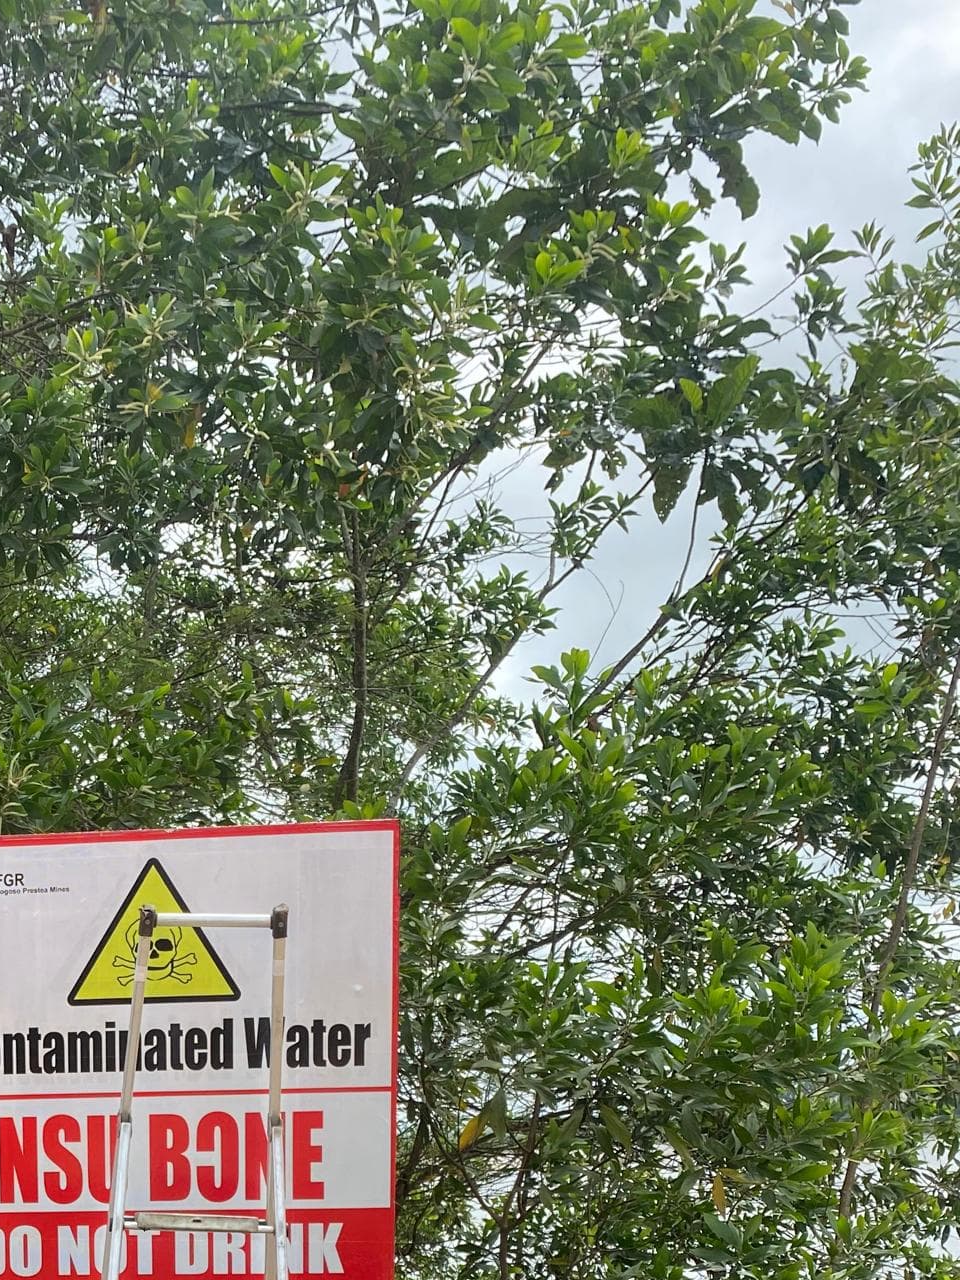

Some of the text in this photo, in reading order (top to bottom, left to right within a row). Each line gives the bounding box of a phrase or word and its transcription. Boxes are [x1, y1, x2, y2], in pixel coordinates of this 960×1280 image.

[22, 886, 49, 894] Prestea
[244, 1016, 372, 1069] Water
[57, 1224, 161, 1276] NOT
